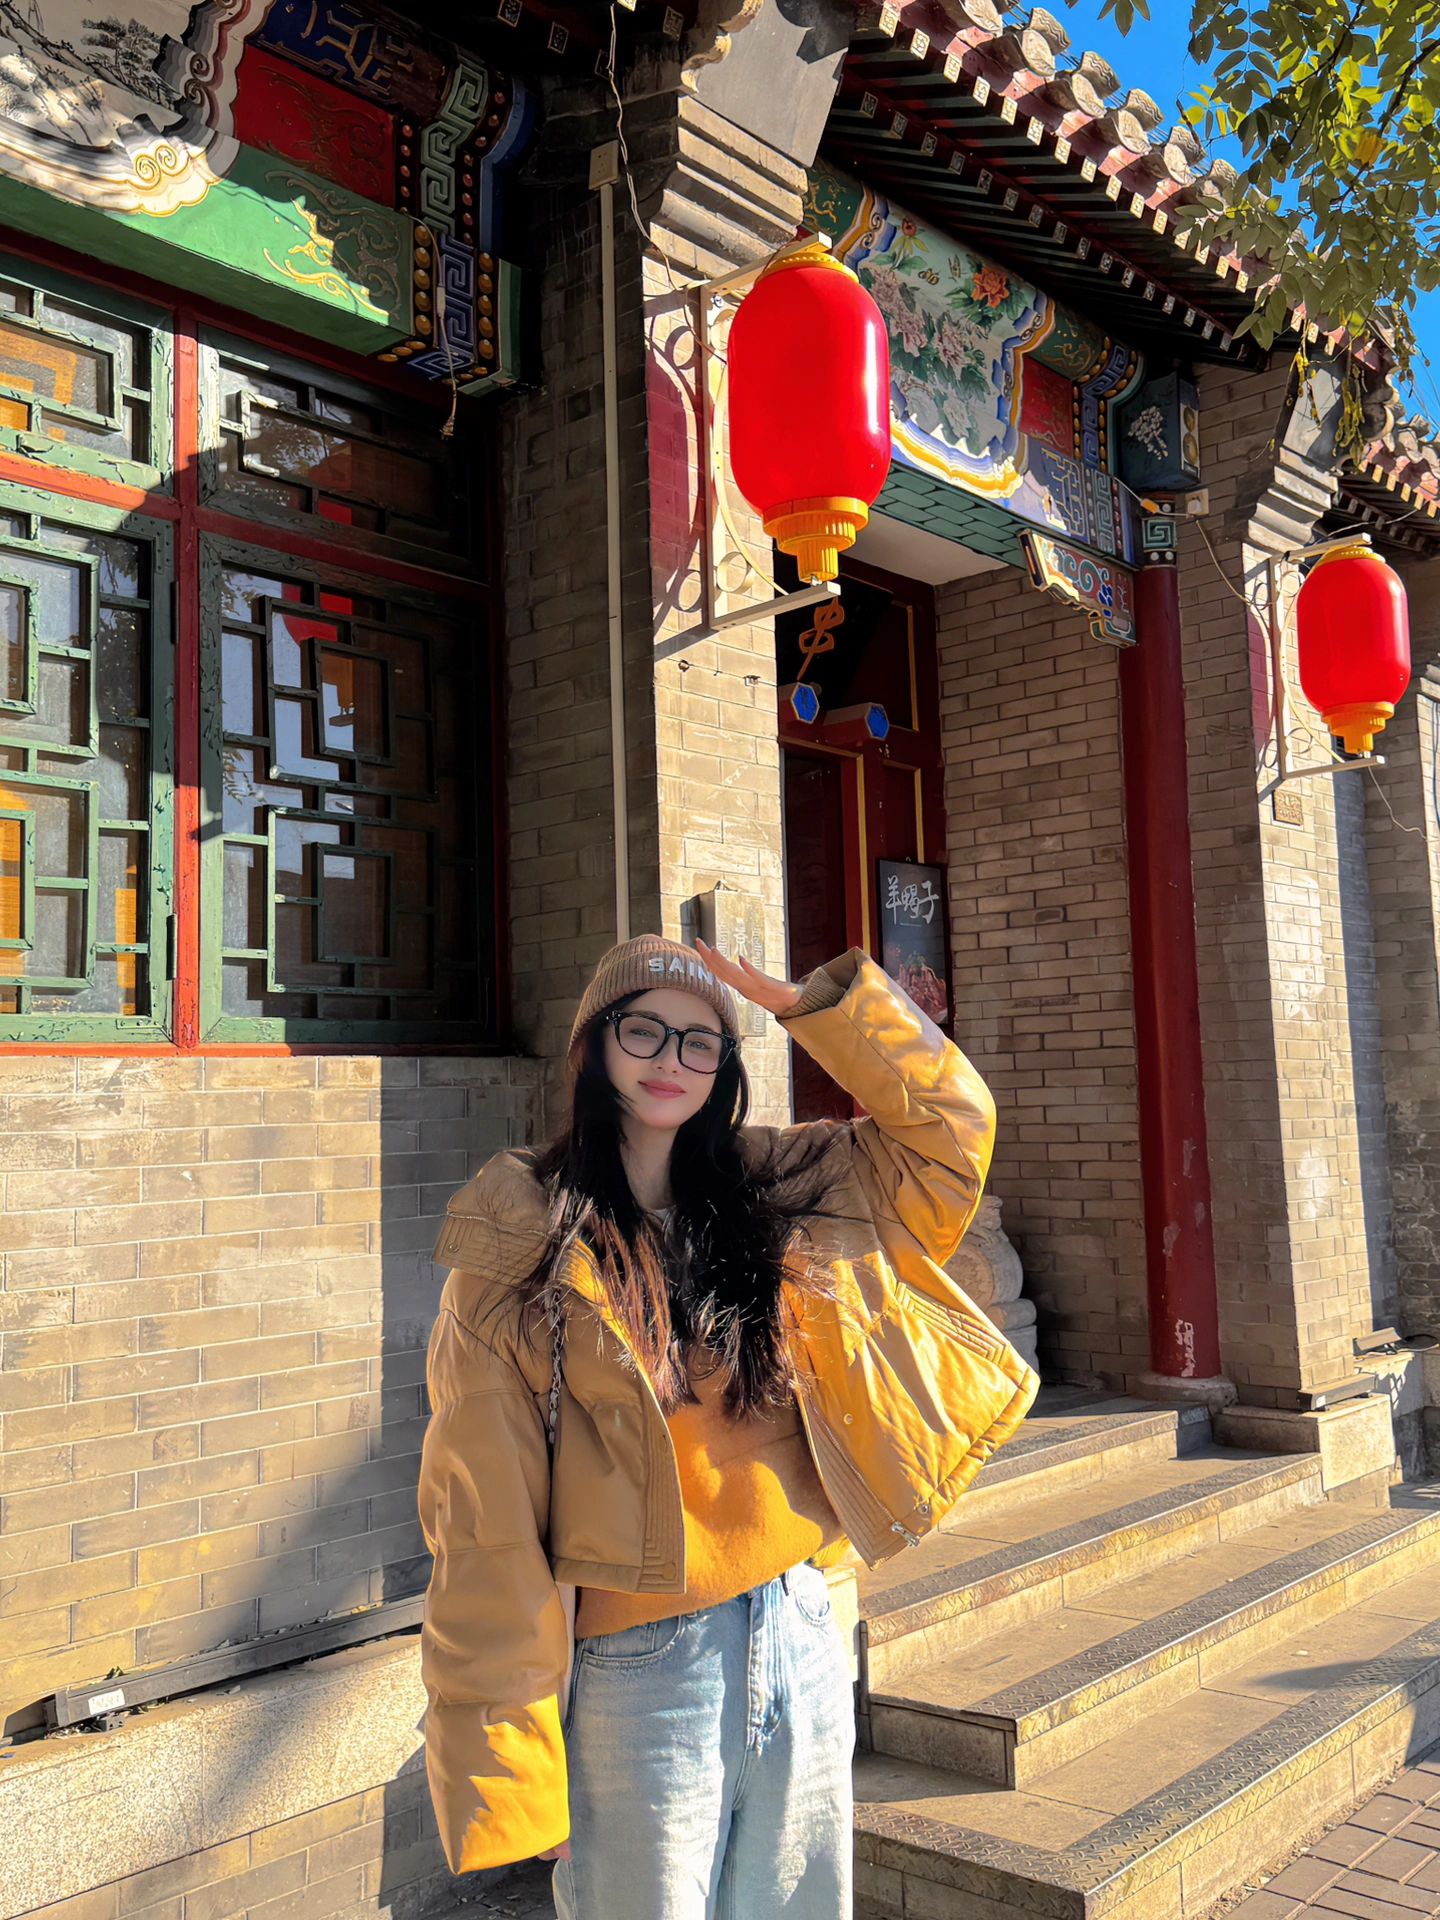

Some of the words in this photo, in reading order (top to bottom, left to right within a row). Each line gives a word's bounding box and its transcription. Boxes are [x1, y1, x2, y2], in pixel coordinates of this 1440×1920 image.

[886, 875, 939, 925] 羊蝎子
[648, 957, 725, 992] SAIN
